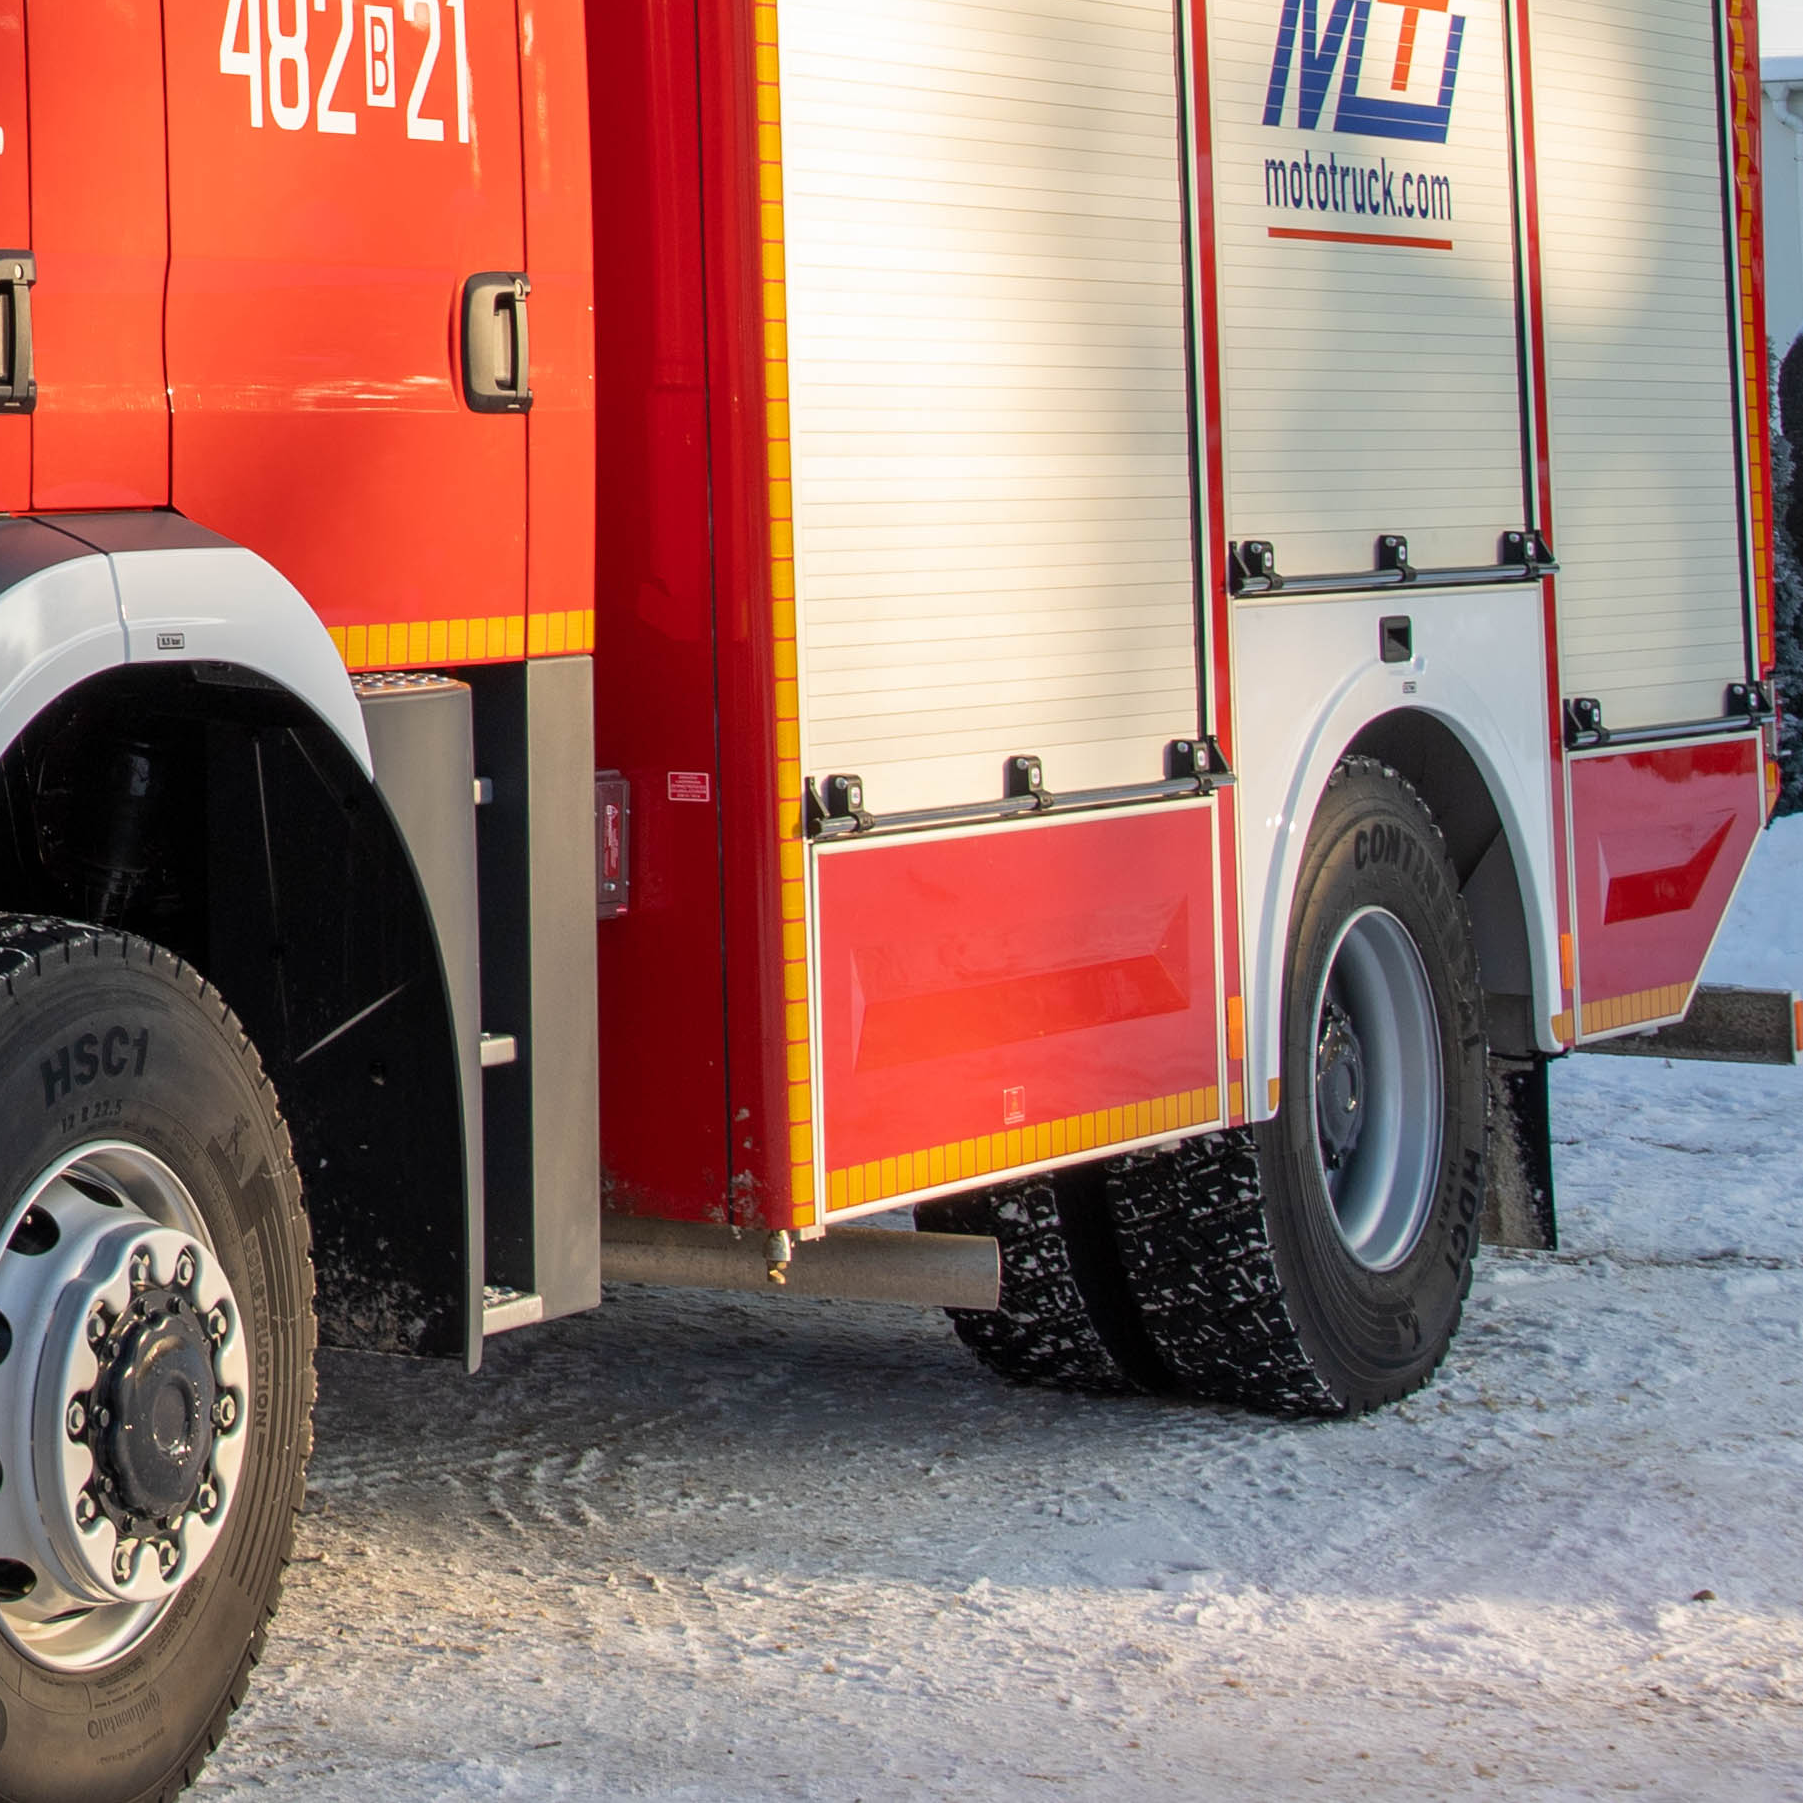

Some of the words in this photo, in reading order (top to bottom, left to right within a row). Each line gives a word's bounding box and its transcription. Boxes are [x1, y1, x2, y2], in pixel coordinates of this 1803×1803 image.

[367, 10, 392, 102] B
[1264, 149, 1452, 221] mototruck.com
[40, 1025, 149, 1108] HSC1
[244, 1234, 271, 1428] CONSTRUCTION
